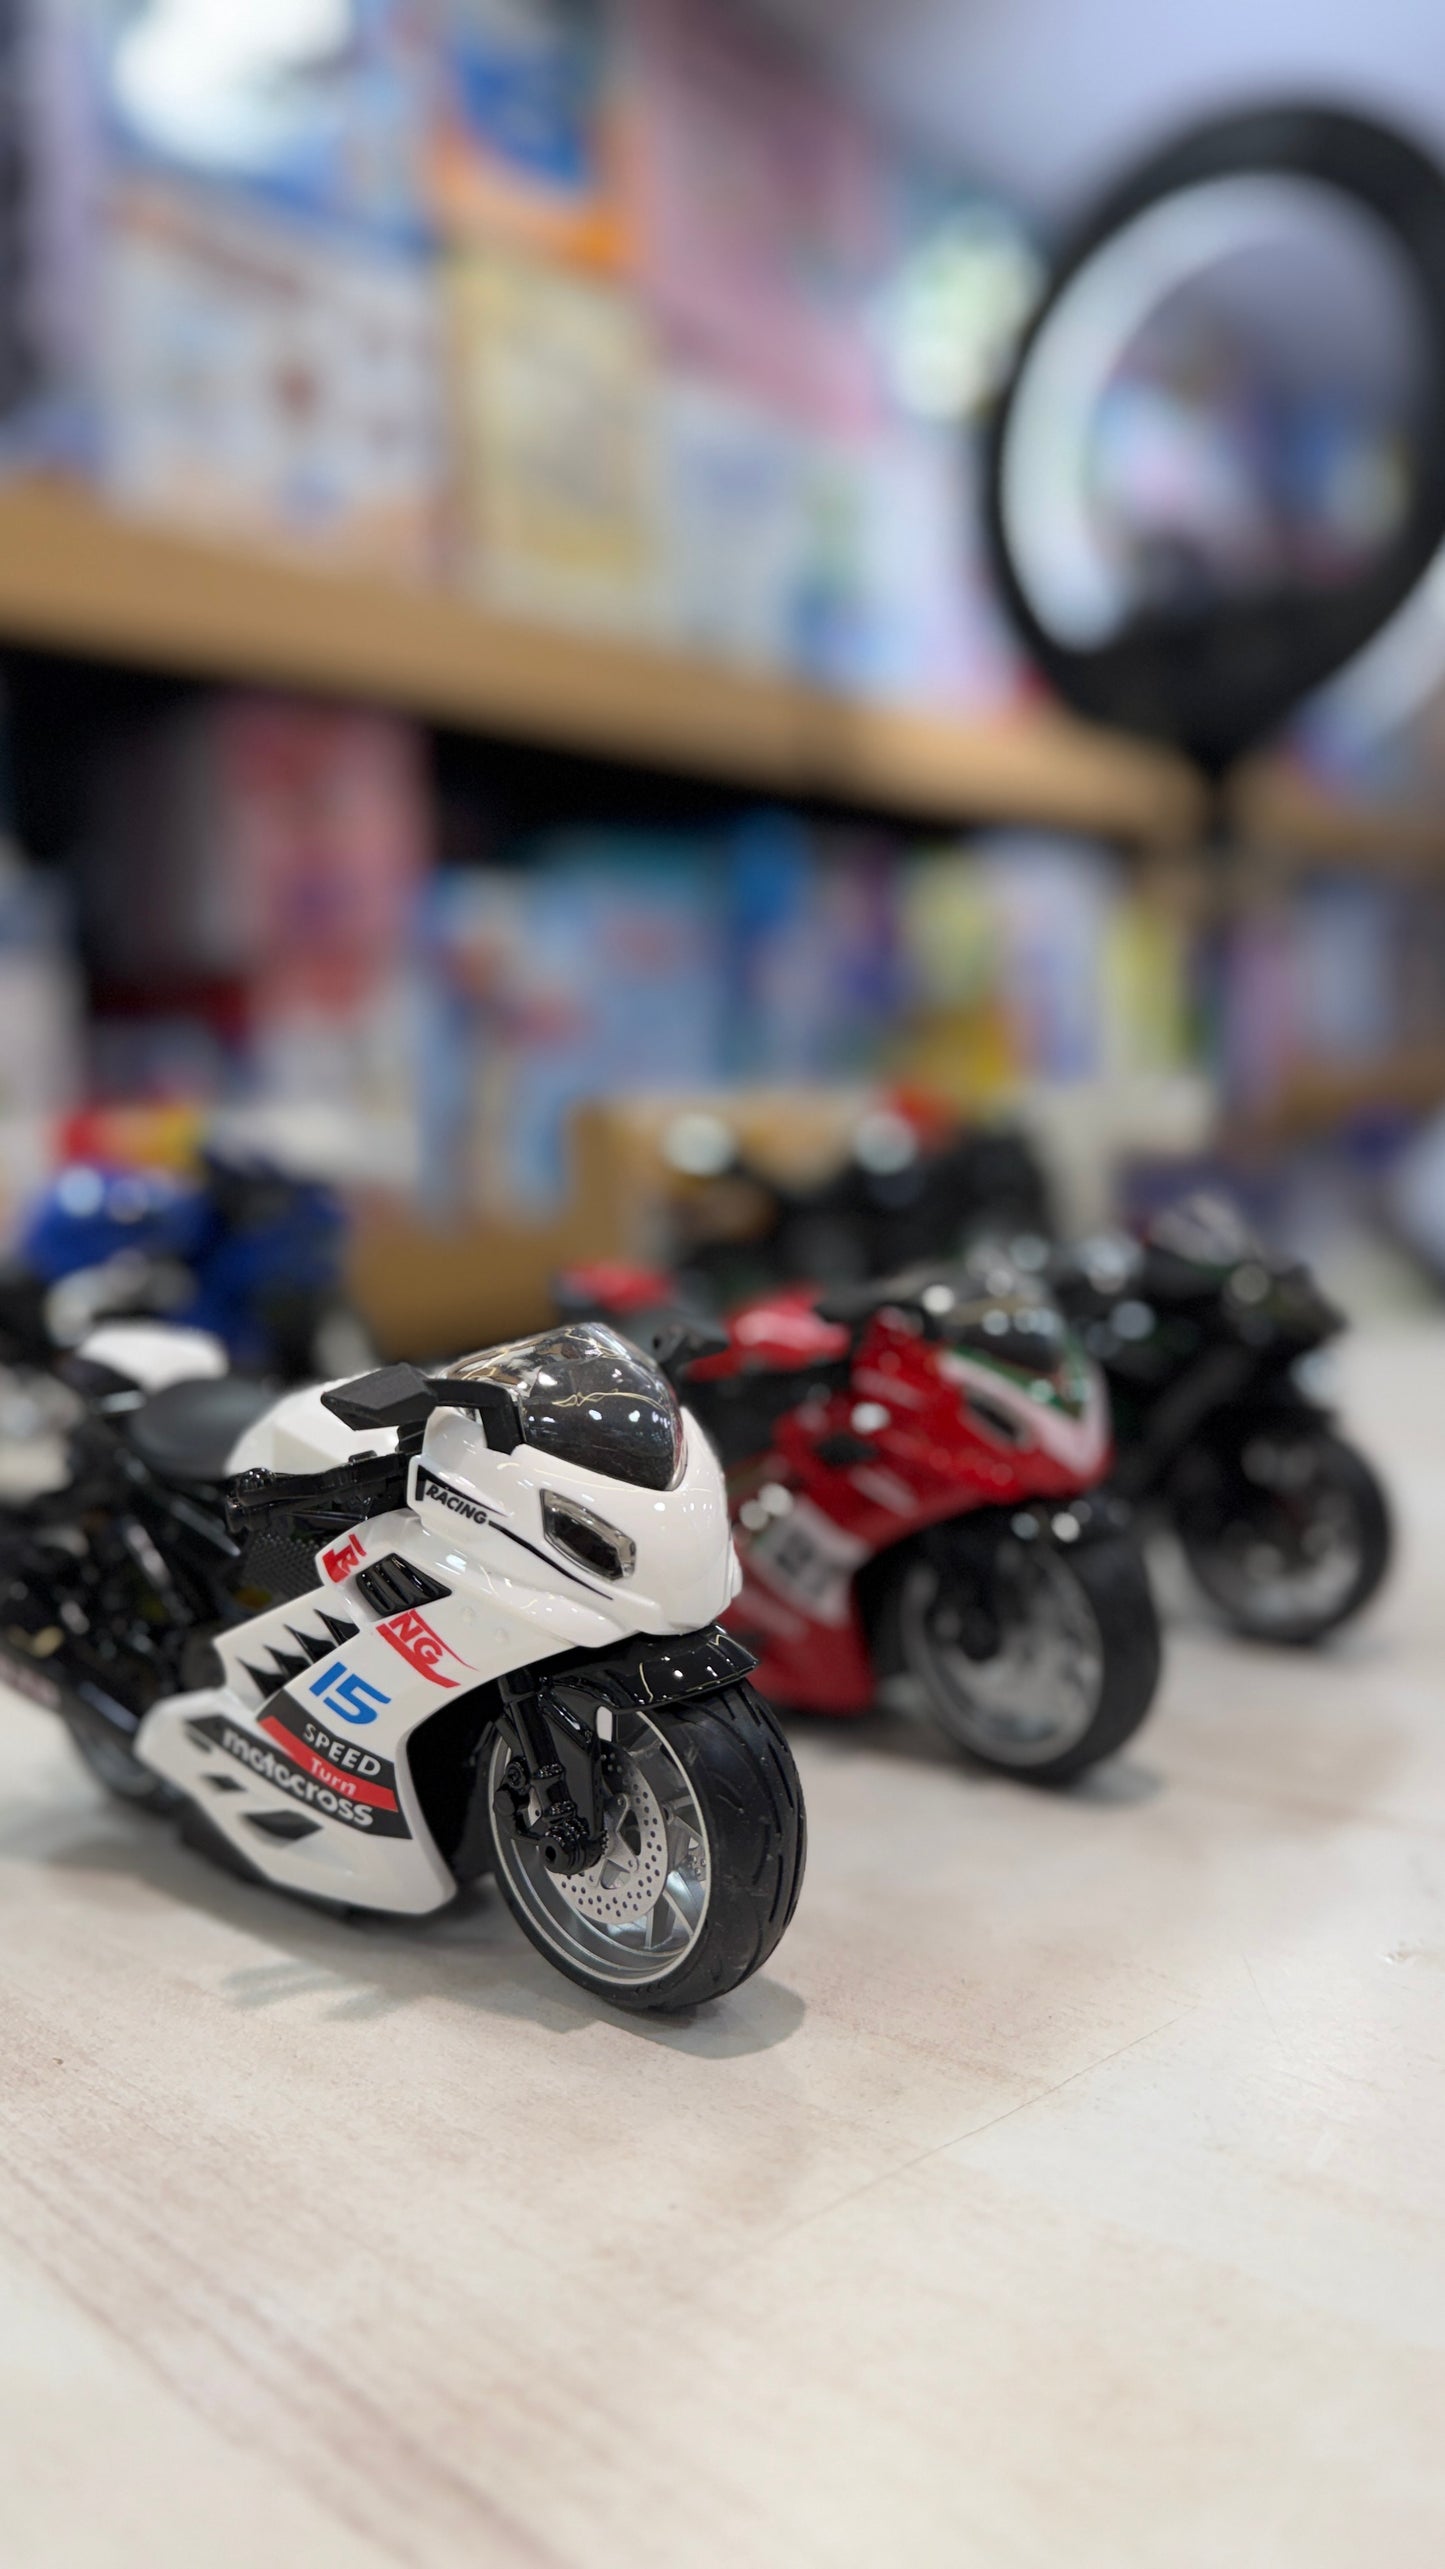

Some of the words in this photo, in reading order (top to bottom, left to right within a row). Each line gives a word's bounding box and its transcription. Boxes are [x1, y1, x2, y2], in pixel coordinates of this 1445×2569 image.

[425, 1484, 488, 1525] RACING
[309, 1661, 392, 1725] 15
[302, 1722, 382, 1776] SPEED
[222, 1728, 374, 1827] motocross
[310, 1756, 357, 1797] Turn
